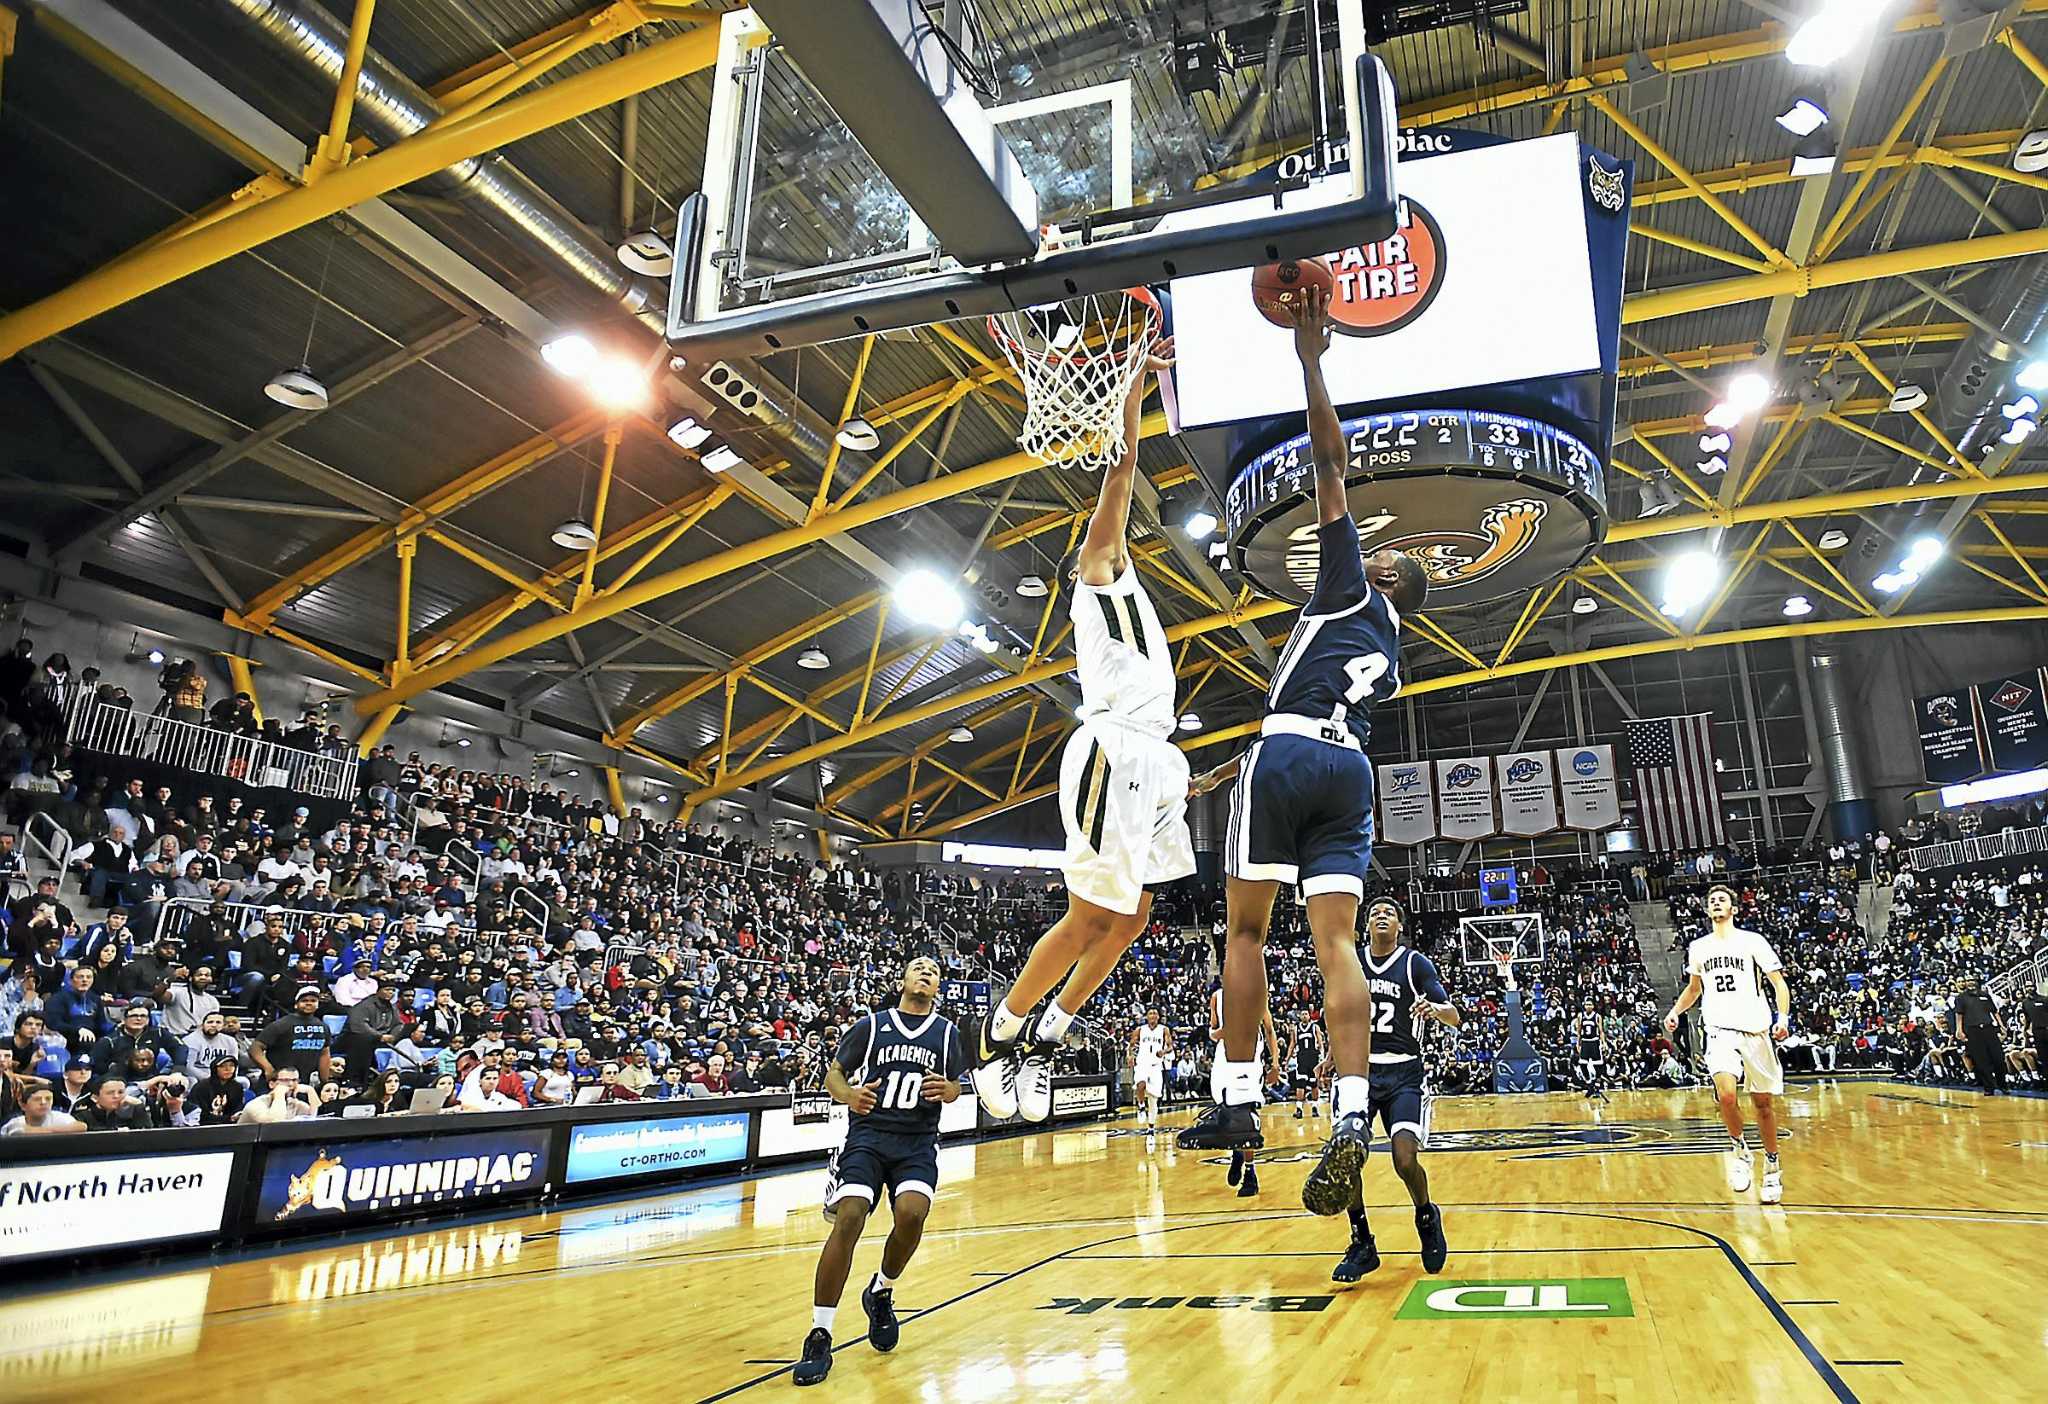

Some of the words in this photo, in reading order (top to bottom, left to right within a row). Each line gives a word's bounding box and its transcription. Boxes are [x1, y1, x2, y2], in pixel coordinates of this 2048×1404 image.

[1337, 263, 1418, 304] TIRE
[1428, 415, 1459, 427] QTR
[1437, 427, 1452, 443] 2
[1487, 423, 1520, 446] 33
[1369, 450, 1412, 467] POSS
[1479, 445, 1496, 454] TOL
[1504, 448, 1530, 460] FOULS
[1568, 446, 1588, 472] 24
[1273, 448, 1299, 478] 24
[1269, 488, 1277, 503] 3
[1291, 479, 1301, 493] 2
[1343, 651, 1390, 705] 4
[2001, 690, 2022, 702] NIT
[1391, 773, 1419, 788] NEC
[1723, 955, 1745, 971] DAME
[1715, 974, 1736, 992] 22
[876, 1044, 937, 1070] ACADEMICS
[881, 1070, 924, 1110] 10
[620, 1148, 707, 1168] CT-ORTHO.COM
[17, 1175, 108, 1206] North
[117, 1172, 204, 1196] Haven
[311, 1151, 535, 1214] QUINNIPIAC
[1034, 1295, 1337, 1315] Bank
[1426, 1284, 1611, 1312] TD
